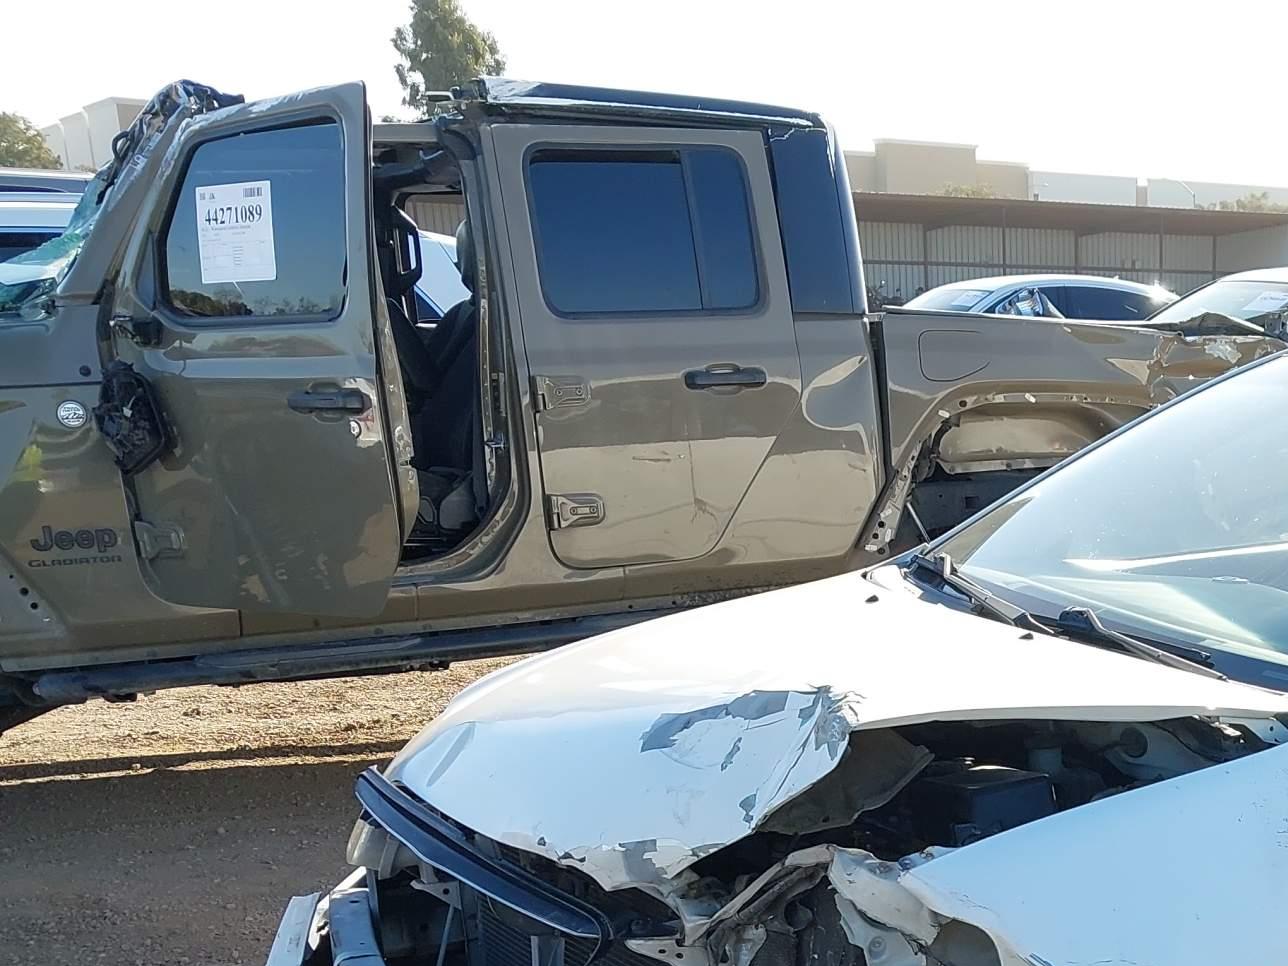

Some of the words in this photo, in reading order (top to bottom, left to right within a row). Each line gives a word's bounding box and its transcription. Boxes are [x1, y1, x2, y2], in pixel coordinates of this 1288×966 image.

[204, 204, 263, 225] 44271089
[29, 525, 118, 553] Jeep
[27, 555, 122, 568] GLADIATOR
